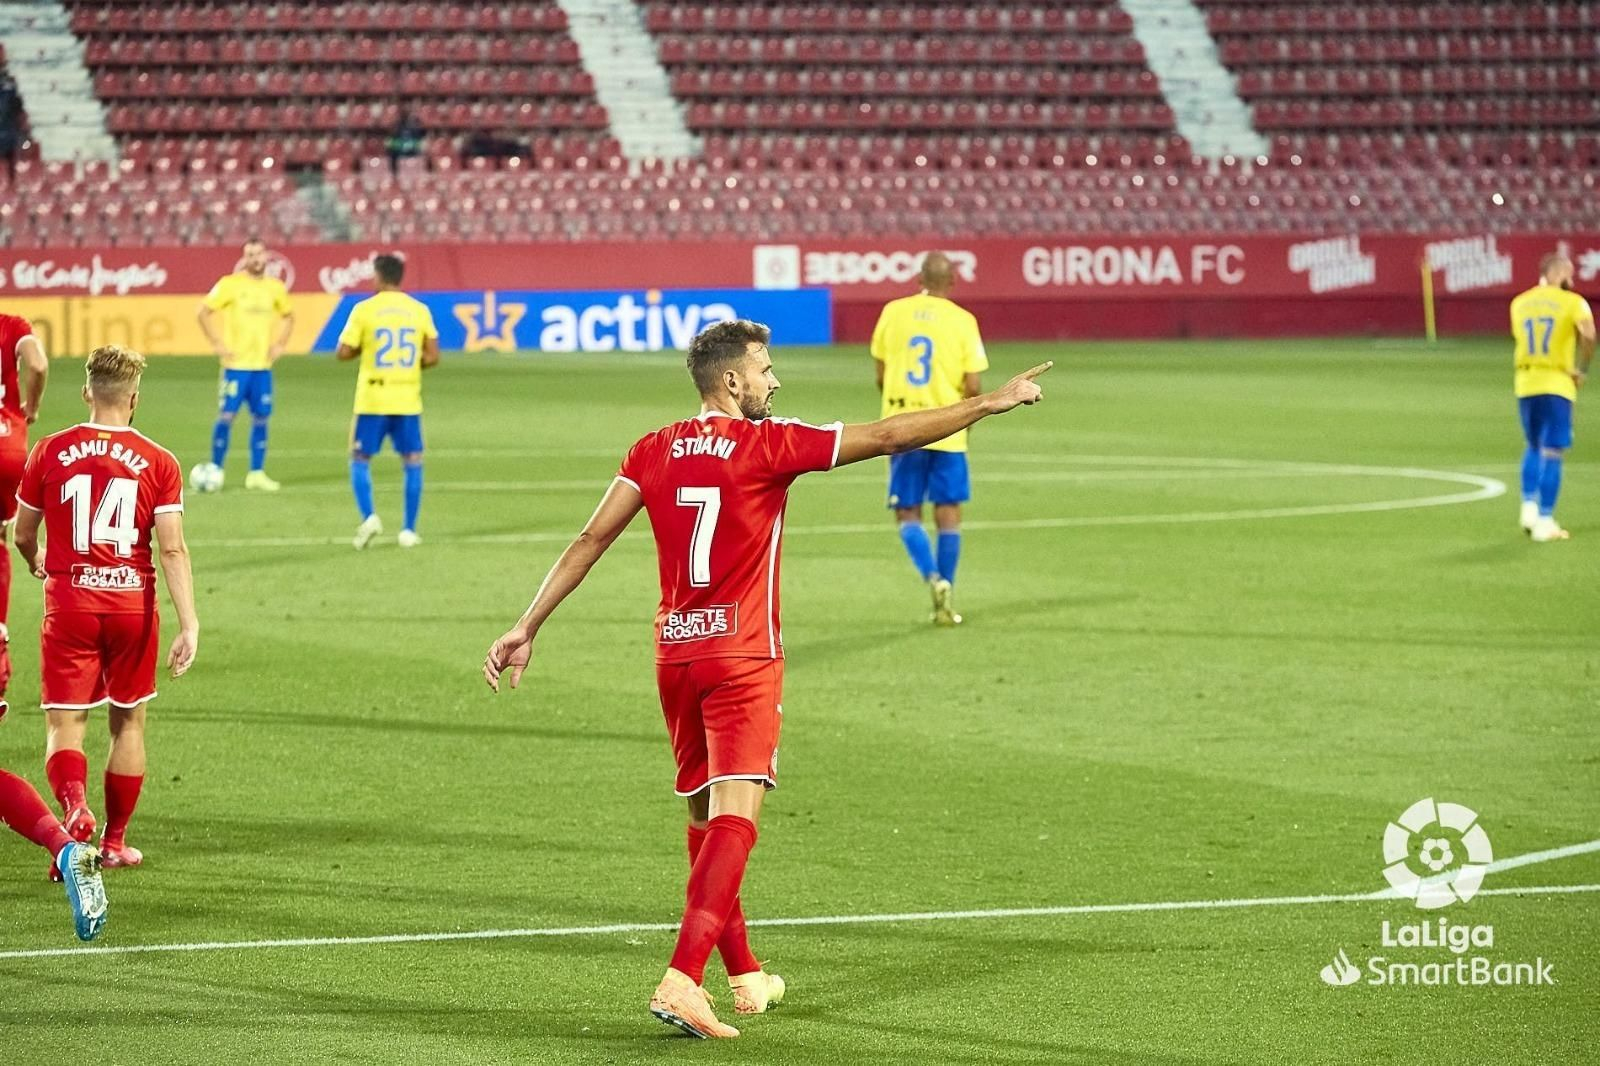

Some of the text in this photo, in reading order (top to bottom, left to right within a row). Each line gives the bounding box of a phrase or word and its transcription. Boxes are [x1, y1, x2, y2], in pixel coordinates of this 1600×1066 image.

[1022, 246, 1182, 286] GIRONA
[1191, 245, 1245, 284] FC
[374, 328, 416, 367] 25
[1524, 316, 1555, 355] 17
[906, 335, 933, 386] 3
[58, 440, 149, 476] SAMU SAIZ
[61, 474, 139, 558] 14
[677, 487, 721, 588] 7
[79, 574, 141, 588] ROSALES
[83, 566, 136, 578] BUFETE
[663, 621, 728, 640] ROSALES
[668, 609, 726, 626] BUFETE
